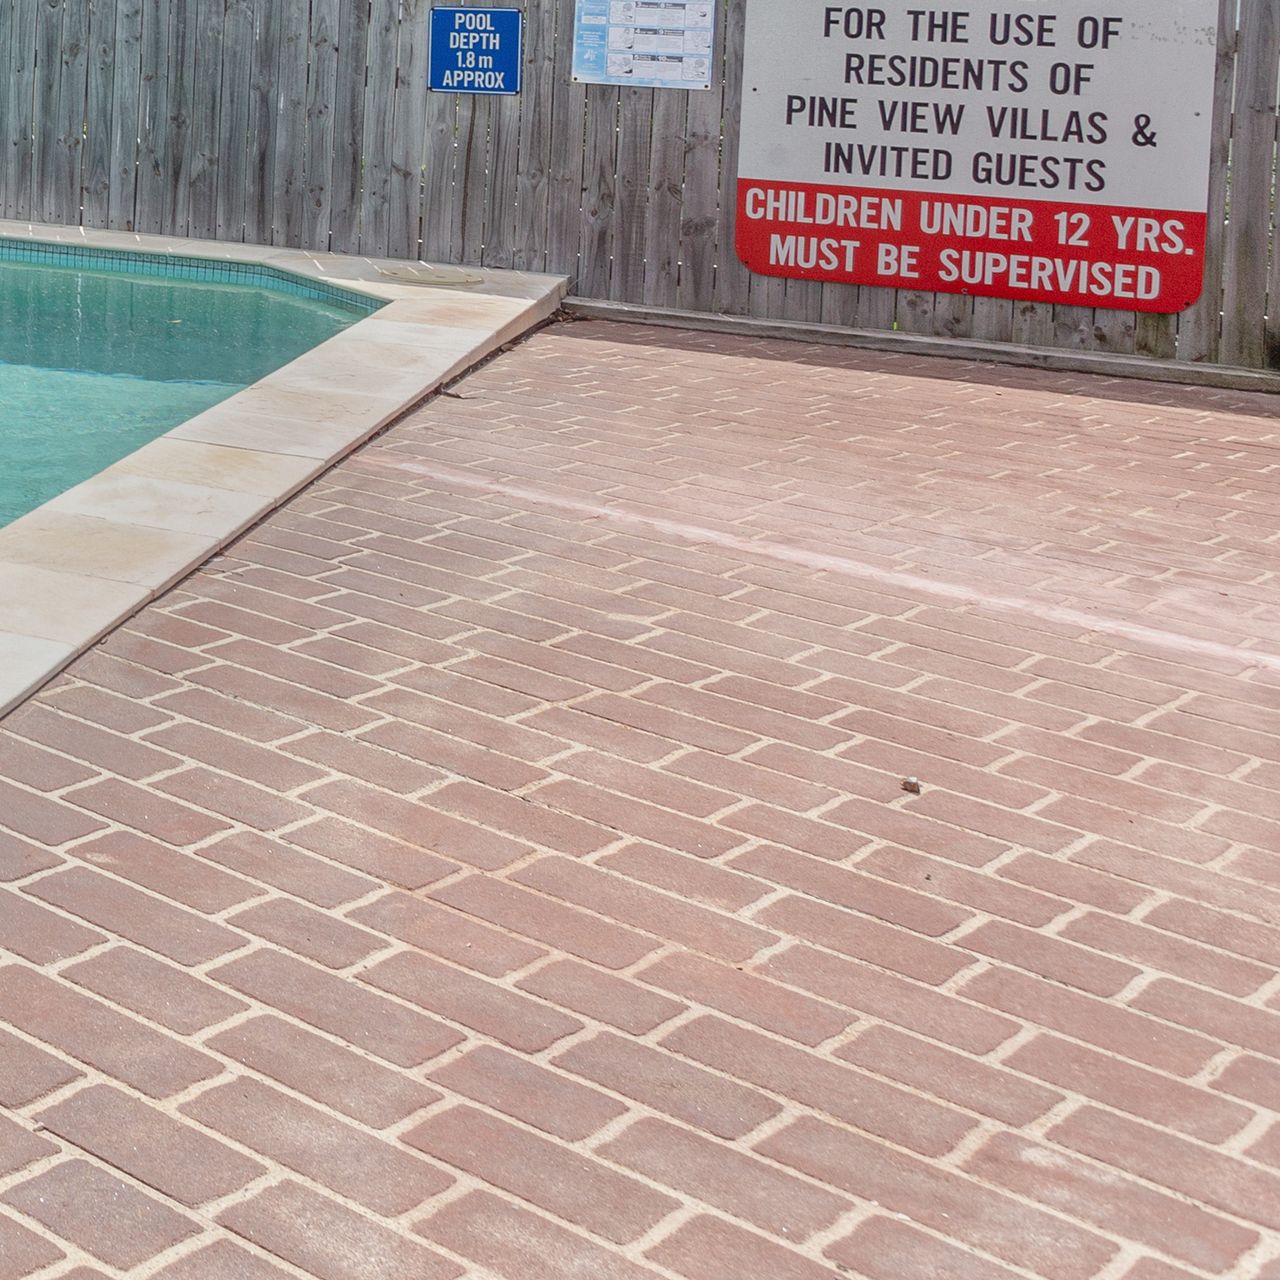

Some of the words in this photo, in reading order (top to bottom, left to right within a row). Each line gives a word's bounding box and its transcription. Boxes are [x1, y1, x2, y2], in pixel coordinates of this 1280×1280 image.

[448, 32, 501, 50] DEPTH
[454, 13, 496, 31] POOL
[823, 7, 887, 41] FOR
[907, 10, 970, 44] THE
[989, 13, 1058, 48] USE
[1076, 16, 1124, 50] OF
[442, 70, 505, 89] APPROX
[843, 53, 1029, 93] RESIDENTS
[1049, 62, 1096, 97] OF
[785, 95, 859, 130] PINE
[878, 100, 966, 136] VIEW
[986, 106, 1109, 144] VILLAS
[1131, 113, 1159, 148] &
[823, 141, 953, 181] INVITED
[972, 152, 1107, 192] GUESTS
[744, 187, 903, 231] CHILDREN
[919, 201, 1035, 242] UNDER
[1053, 211, 1091, 247] 12
[1111, 215, 1195, 256] YRS.
[769, 233, 861, 272] MUST
[876, 244, 921, 279] BE
[938, 248, 1161, 301] SUPERVISED
